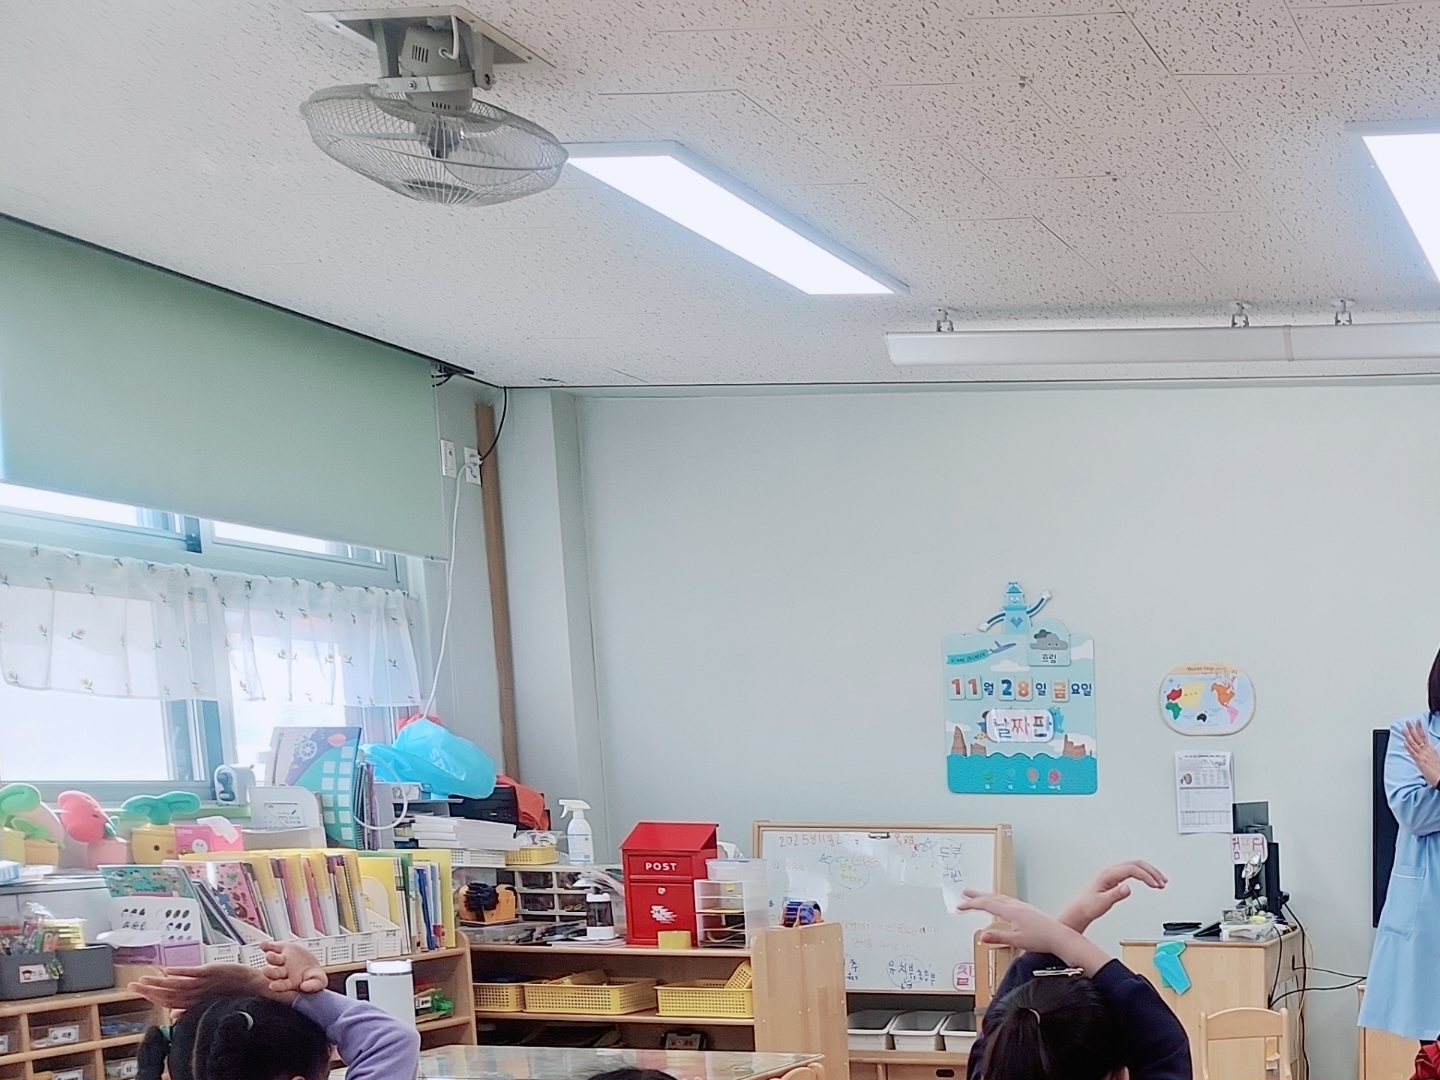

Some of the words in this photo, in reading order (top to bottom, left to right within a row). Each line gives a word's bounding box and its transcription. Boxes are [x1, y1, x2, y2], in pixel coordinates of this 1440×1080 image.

[1041, 653, 1057, 663] 흐림
[950, 678, 995, 696] 11월
[1000, 679, 1047, 697] 28일
[1053, 681, 1092, 699] 금요일
[645, 862, 678, 871] POST
